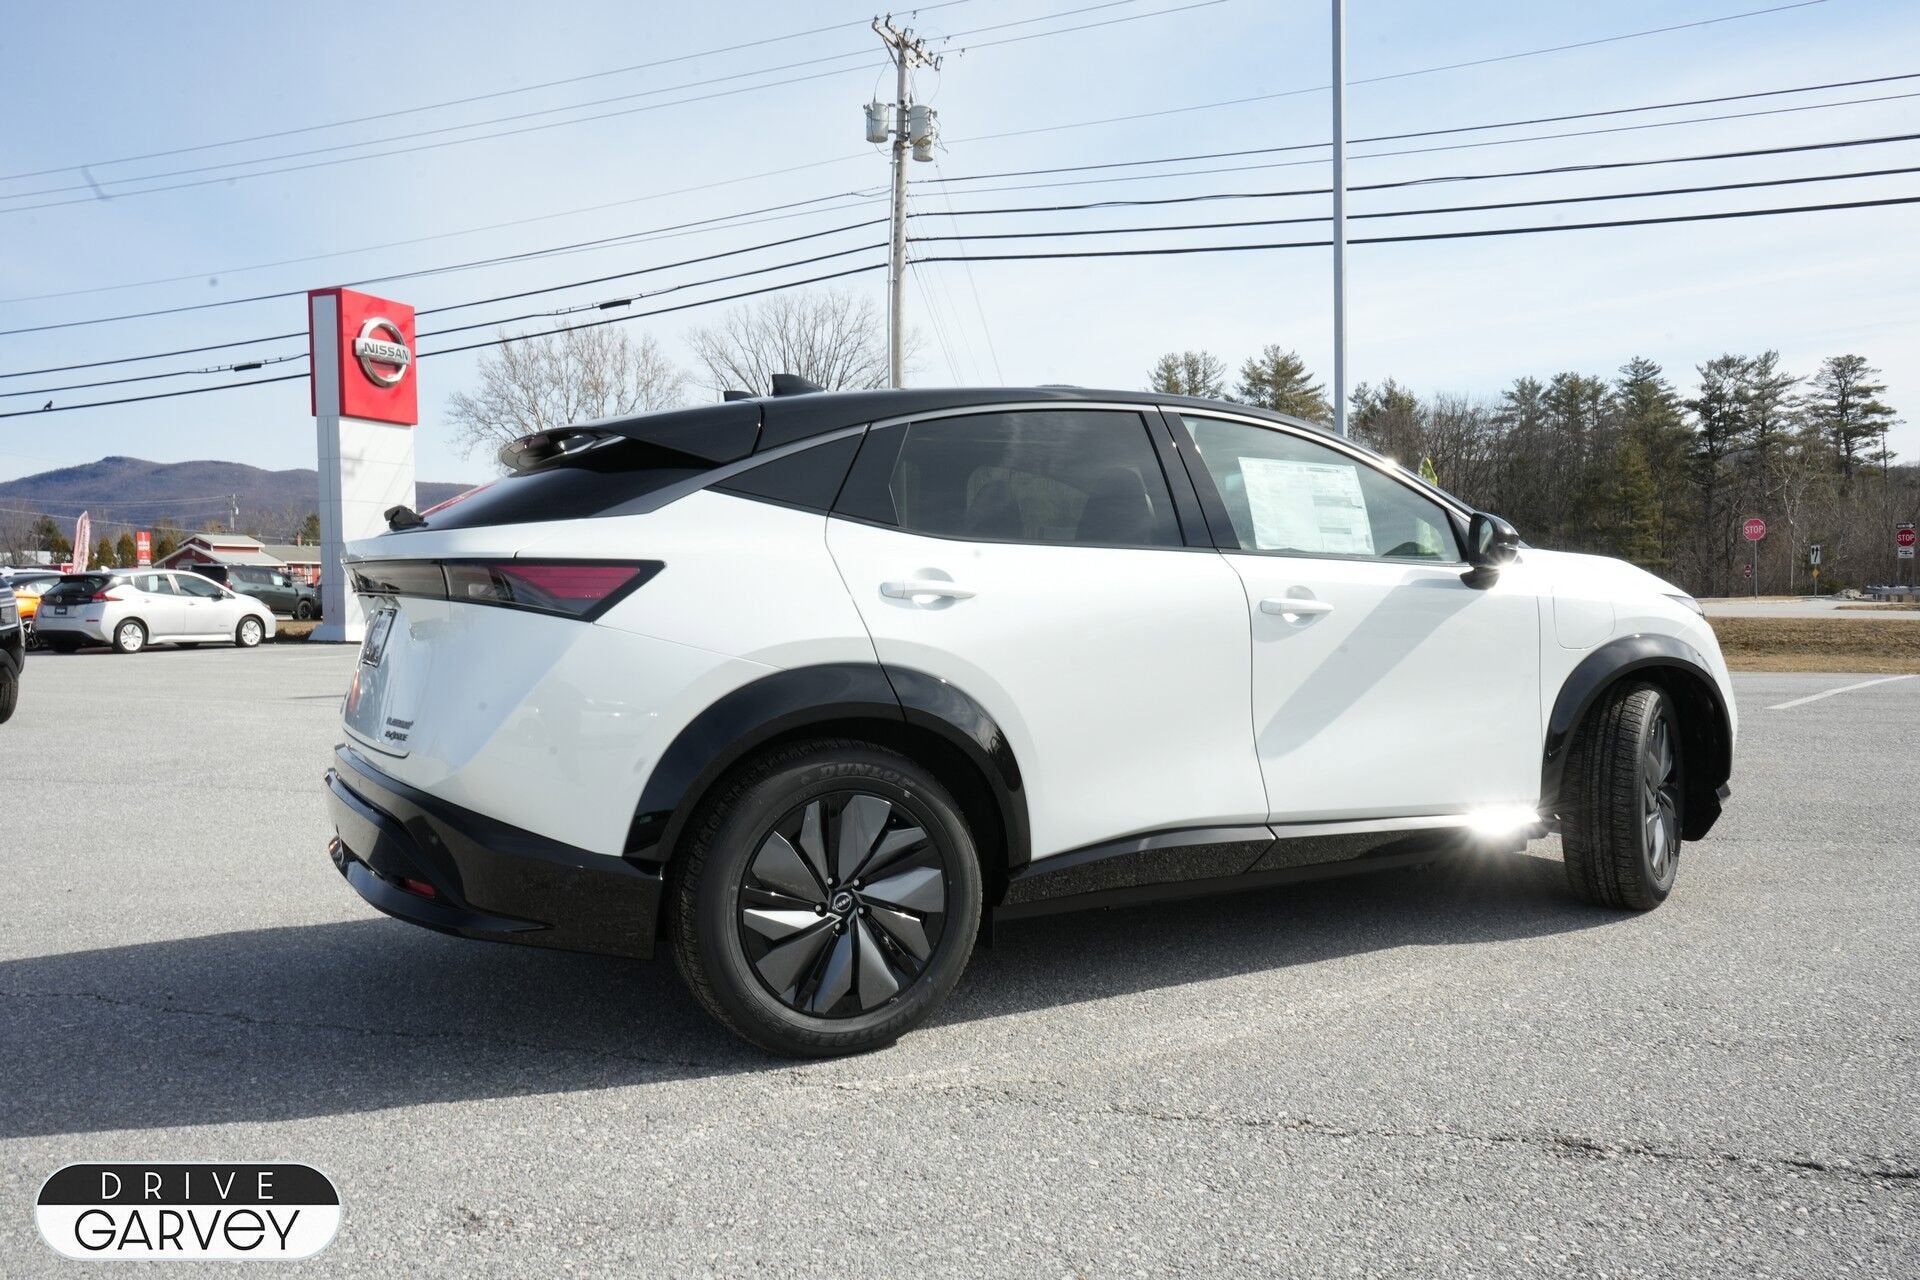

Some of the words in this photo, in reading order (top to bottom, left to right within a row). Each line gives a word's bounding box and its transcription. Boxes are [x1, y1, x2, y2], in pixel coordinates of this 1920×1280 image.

[364, 342, 410, 361] NISSAN
[1744, 525, 1764, 534] STOP
[1897, 534, 1915, 542] STOP
[818, 762, 916, 787] DUNLOP
